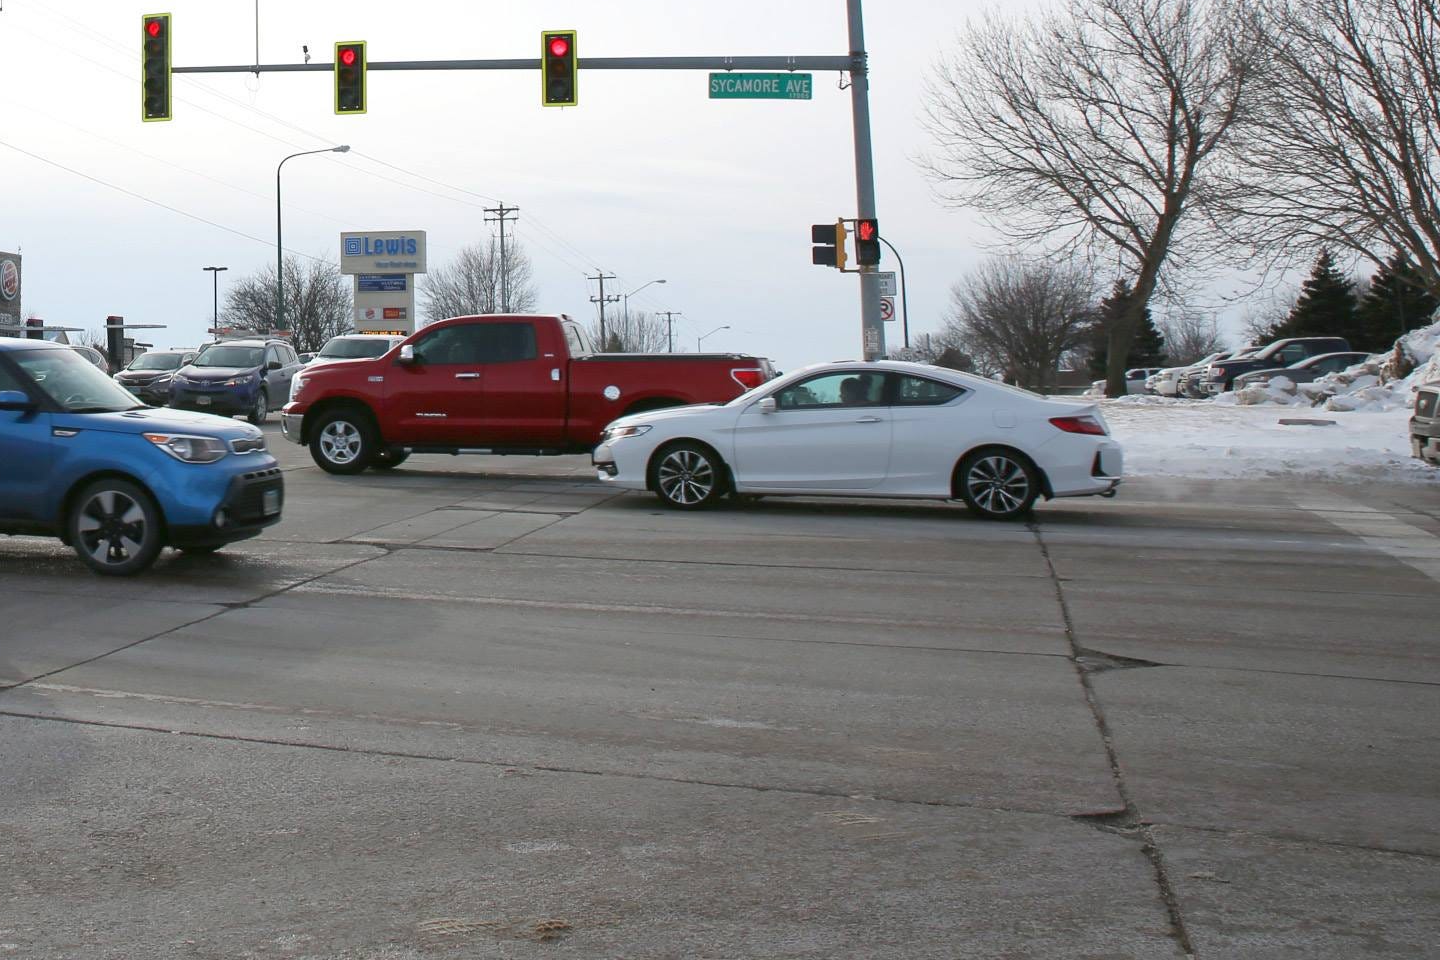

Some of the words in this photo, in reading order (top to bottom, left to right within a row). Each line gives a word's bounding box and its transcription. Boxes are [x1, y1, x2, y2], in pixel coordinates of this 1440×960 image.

[711, 79, 780, 93] SYCAMORE
[785, 79, 810, 93] AVE
[364, 236, 417, 255] Lewis
